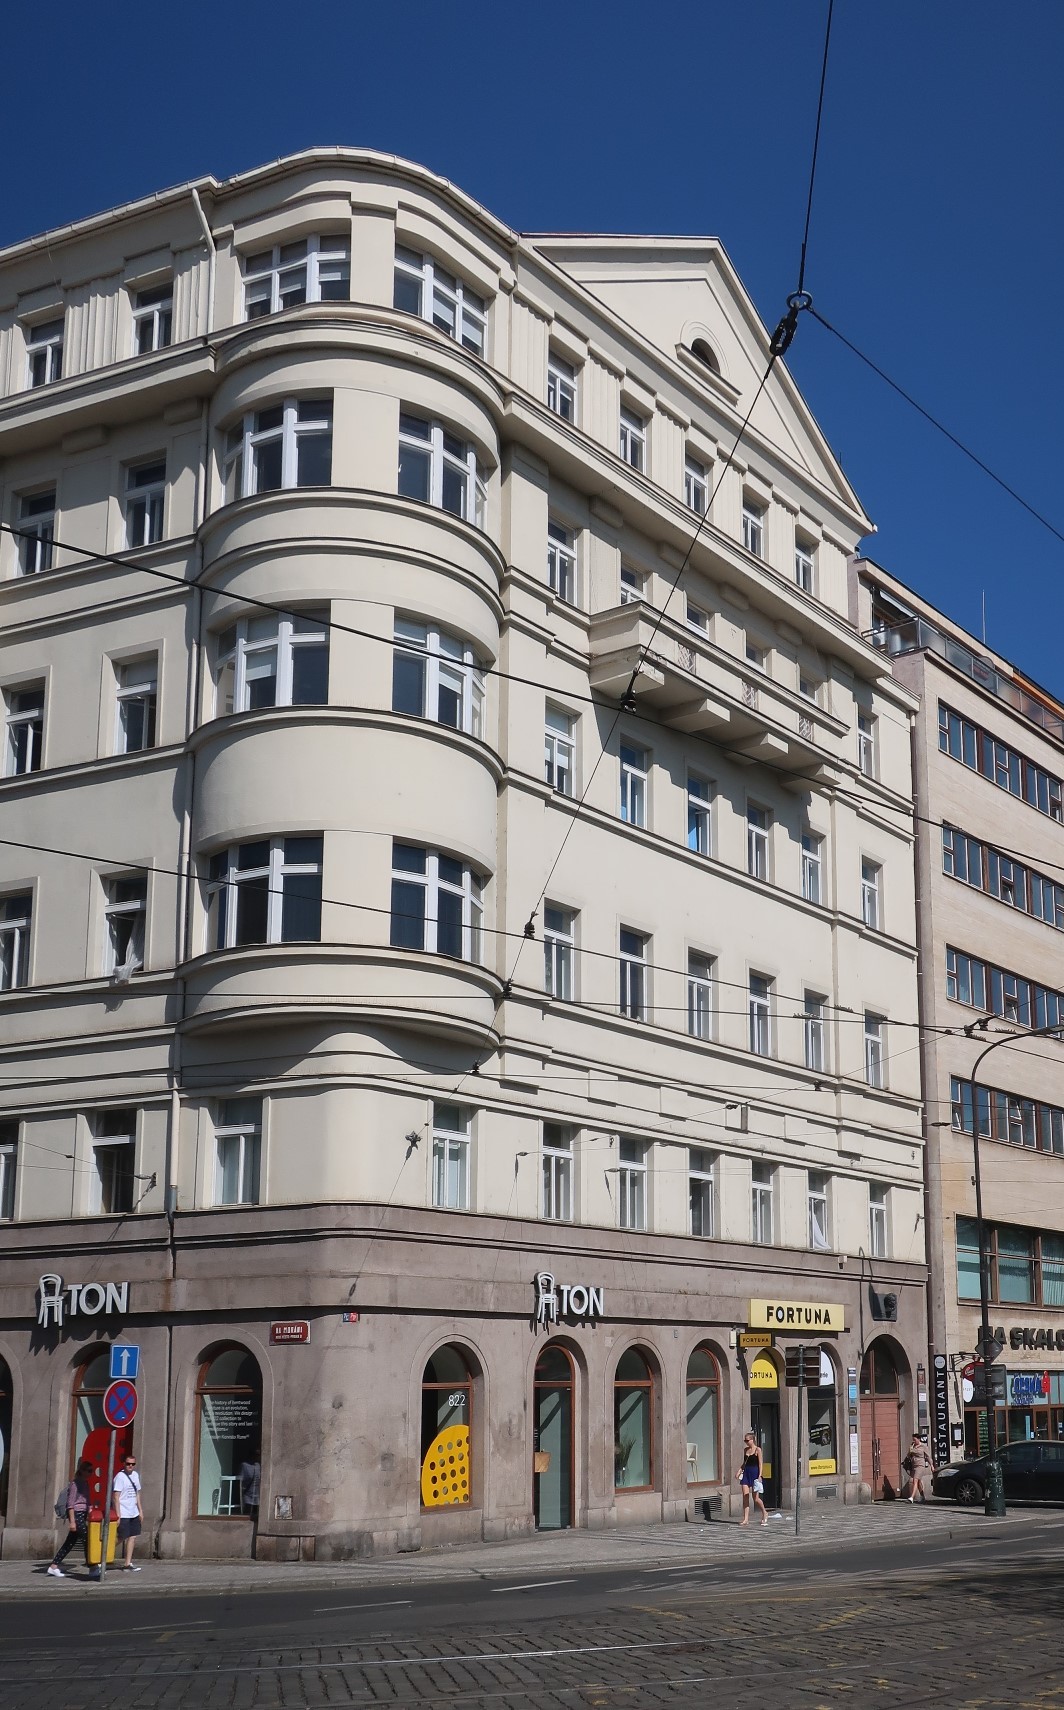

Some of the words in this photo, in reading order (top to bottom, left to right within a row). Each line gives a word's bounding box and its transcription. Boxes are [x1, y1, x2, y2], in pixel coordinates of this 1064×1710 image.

[67, 1281, 128, 1315] TON
[560, 1285, 604, 1316] TON
[766, 1306, 831, 1325] FORTUNA
[449, 1394, 466, 1406] 822
[937, 1371, 948, 1467] RESTAURANT
